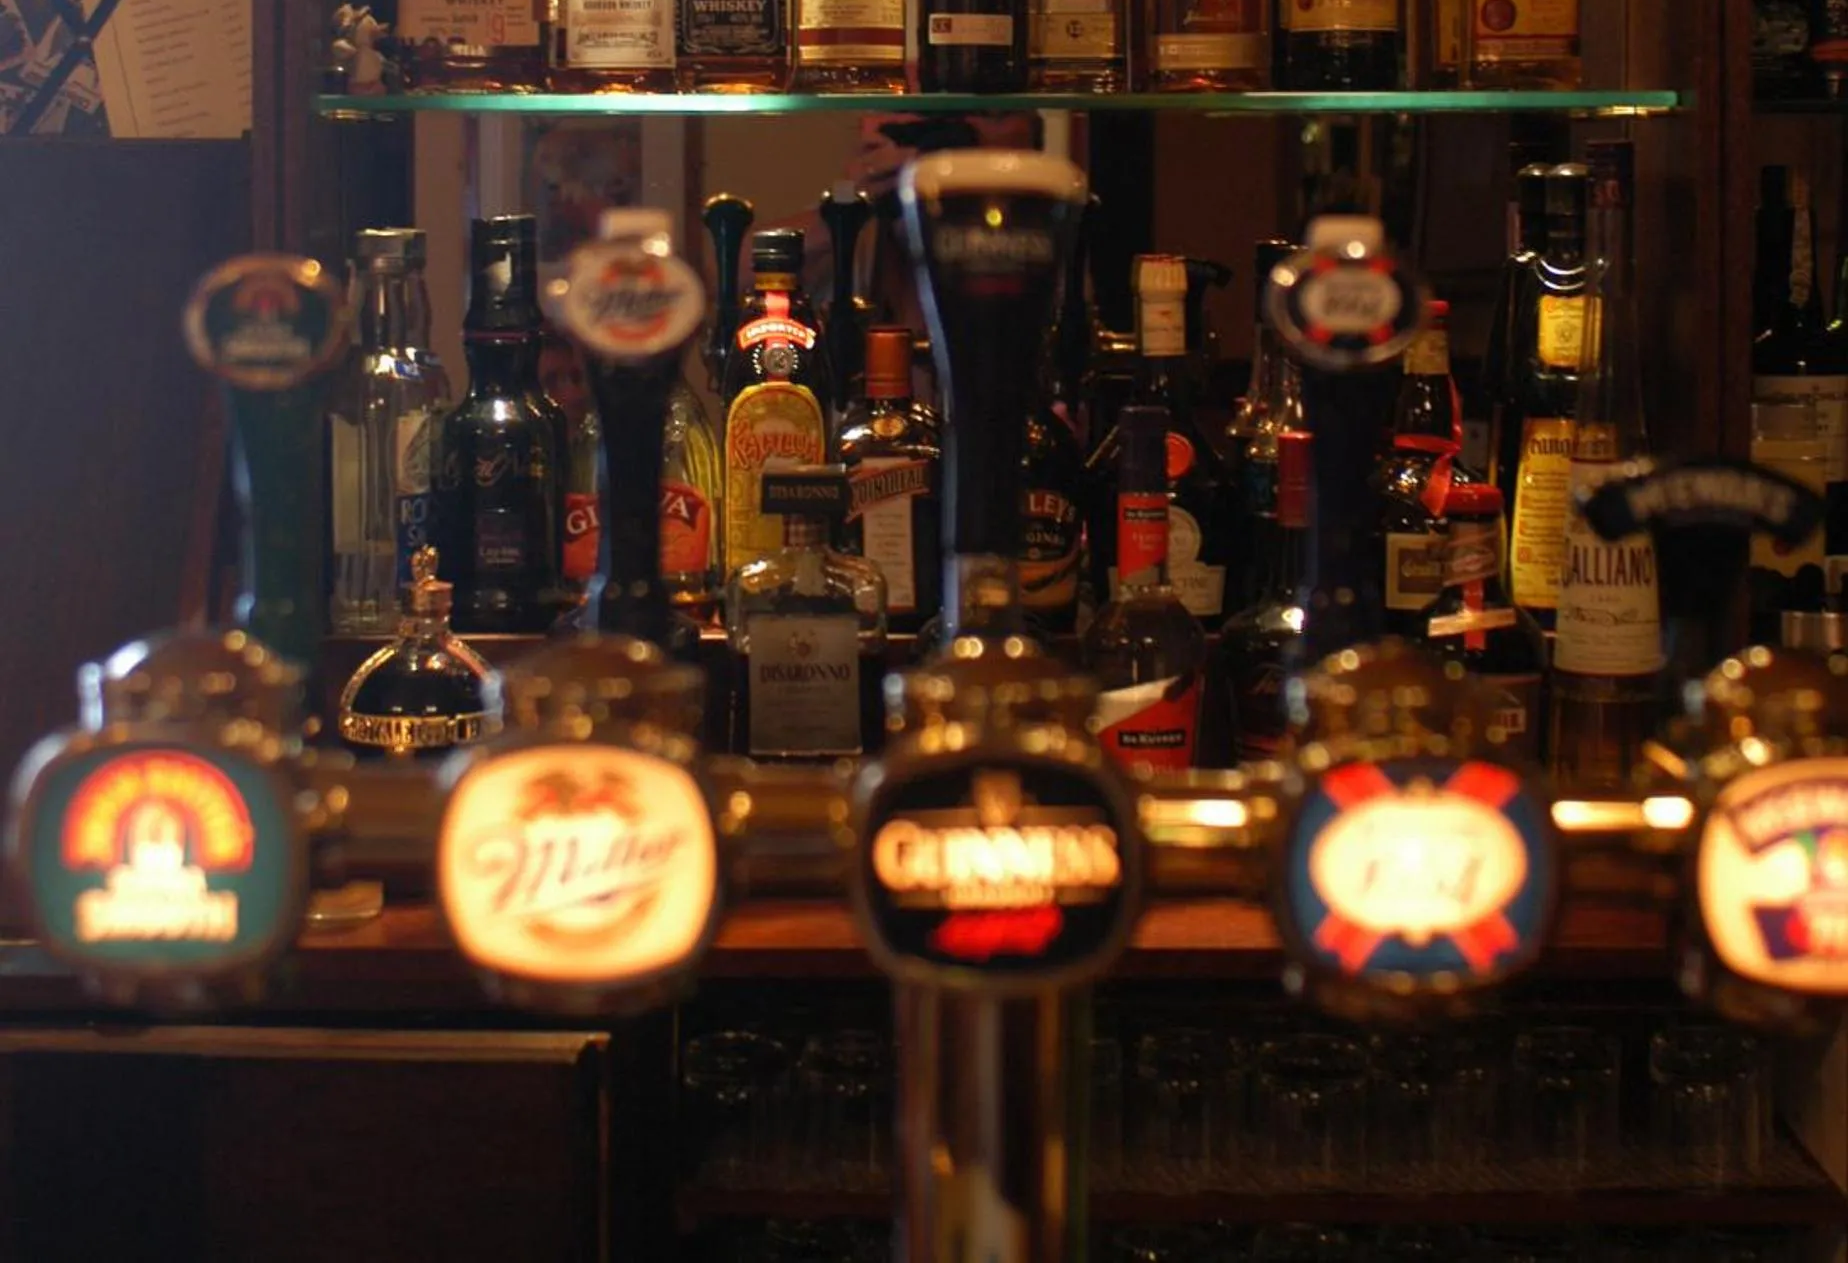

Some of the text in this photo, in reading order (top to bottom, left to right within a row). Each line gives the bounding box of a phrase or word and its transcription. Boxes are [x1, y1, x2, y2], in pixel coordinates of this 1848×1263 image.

[692, 0, 767, 12] WHISKEY
[1028, 492, 1077, 523] LEYS
[759, 662, 851, 683] DISARONNO
